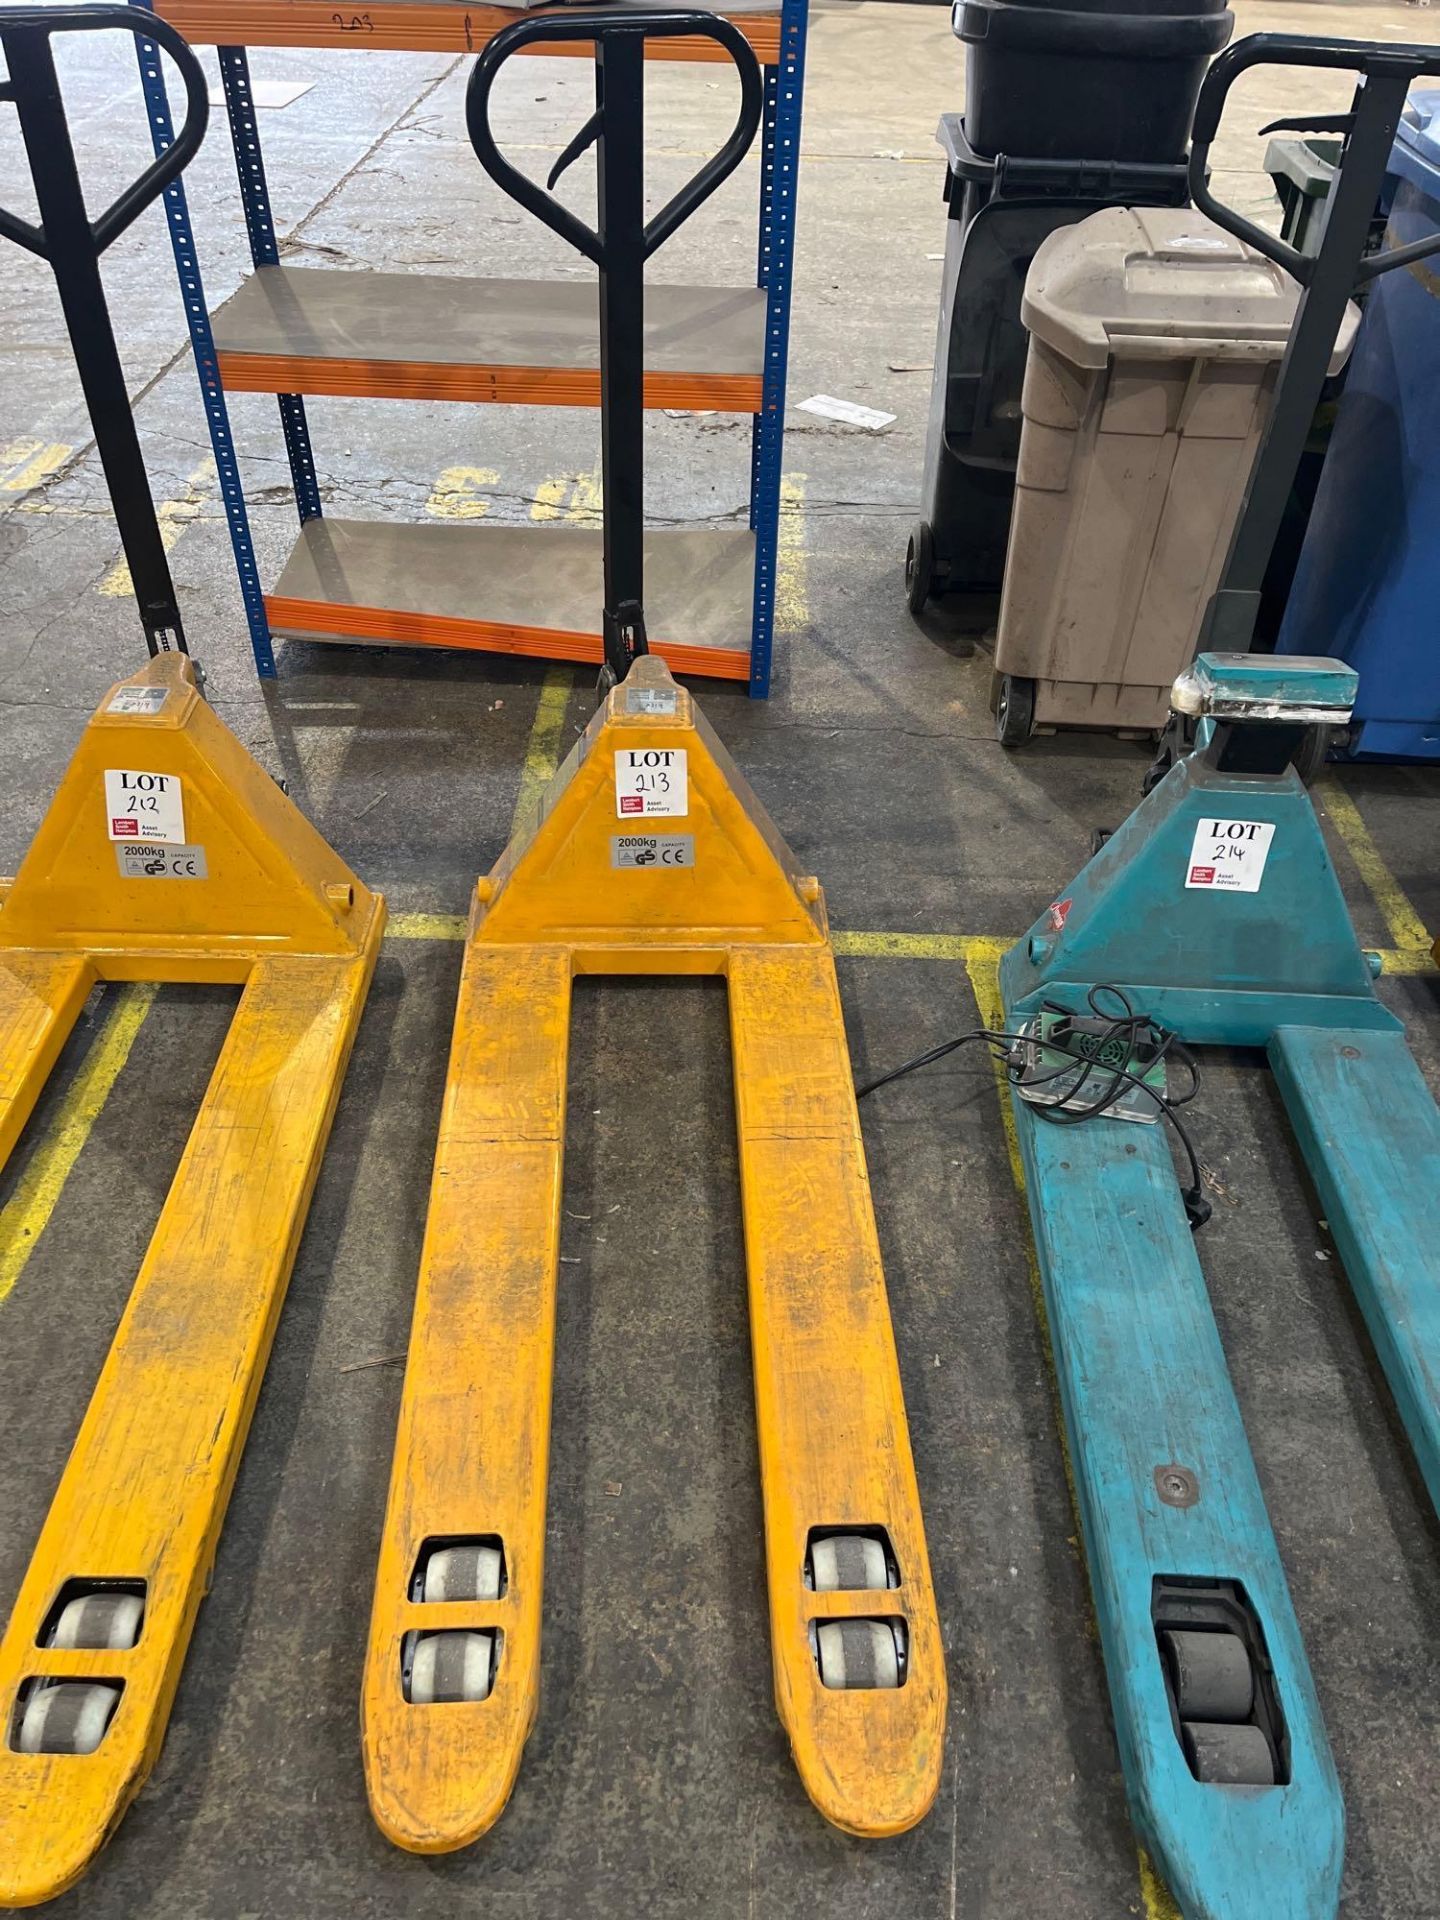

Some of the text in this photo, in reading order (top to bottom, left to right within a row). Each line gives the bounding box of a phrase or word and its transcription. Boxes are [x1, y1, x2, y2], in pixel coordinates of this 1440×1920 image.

[629, 752, 675, 767] LOT
[121, 773, 169, 792] LOT
[635, 772, 670, 792] 213
[127, 795, 160, 814] 212
[142, 831, 167, 839] Advisory
[1210, 822, 1262, 840] LOT
[618, 837, 657, 849] 2000kg
[124, 846, 166, 859] 2000kg
[662, 849, 684, 864] CE
[1212, 844, 1246, 862] 214
[172, 861, 197, 876] CE
